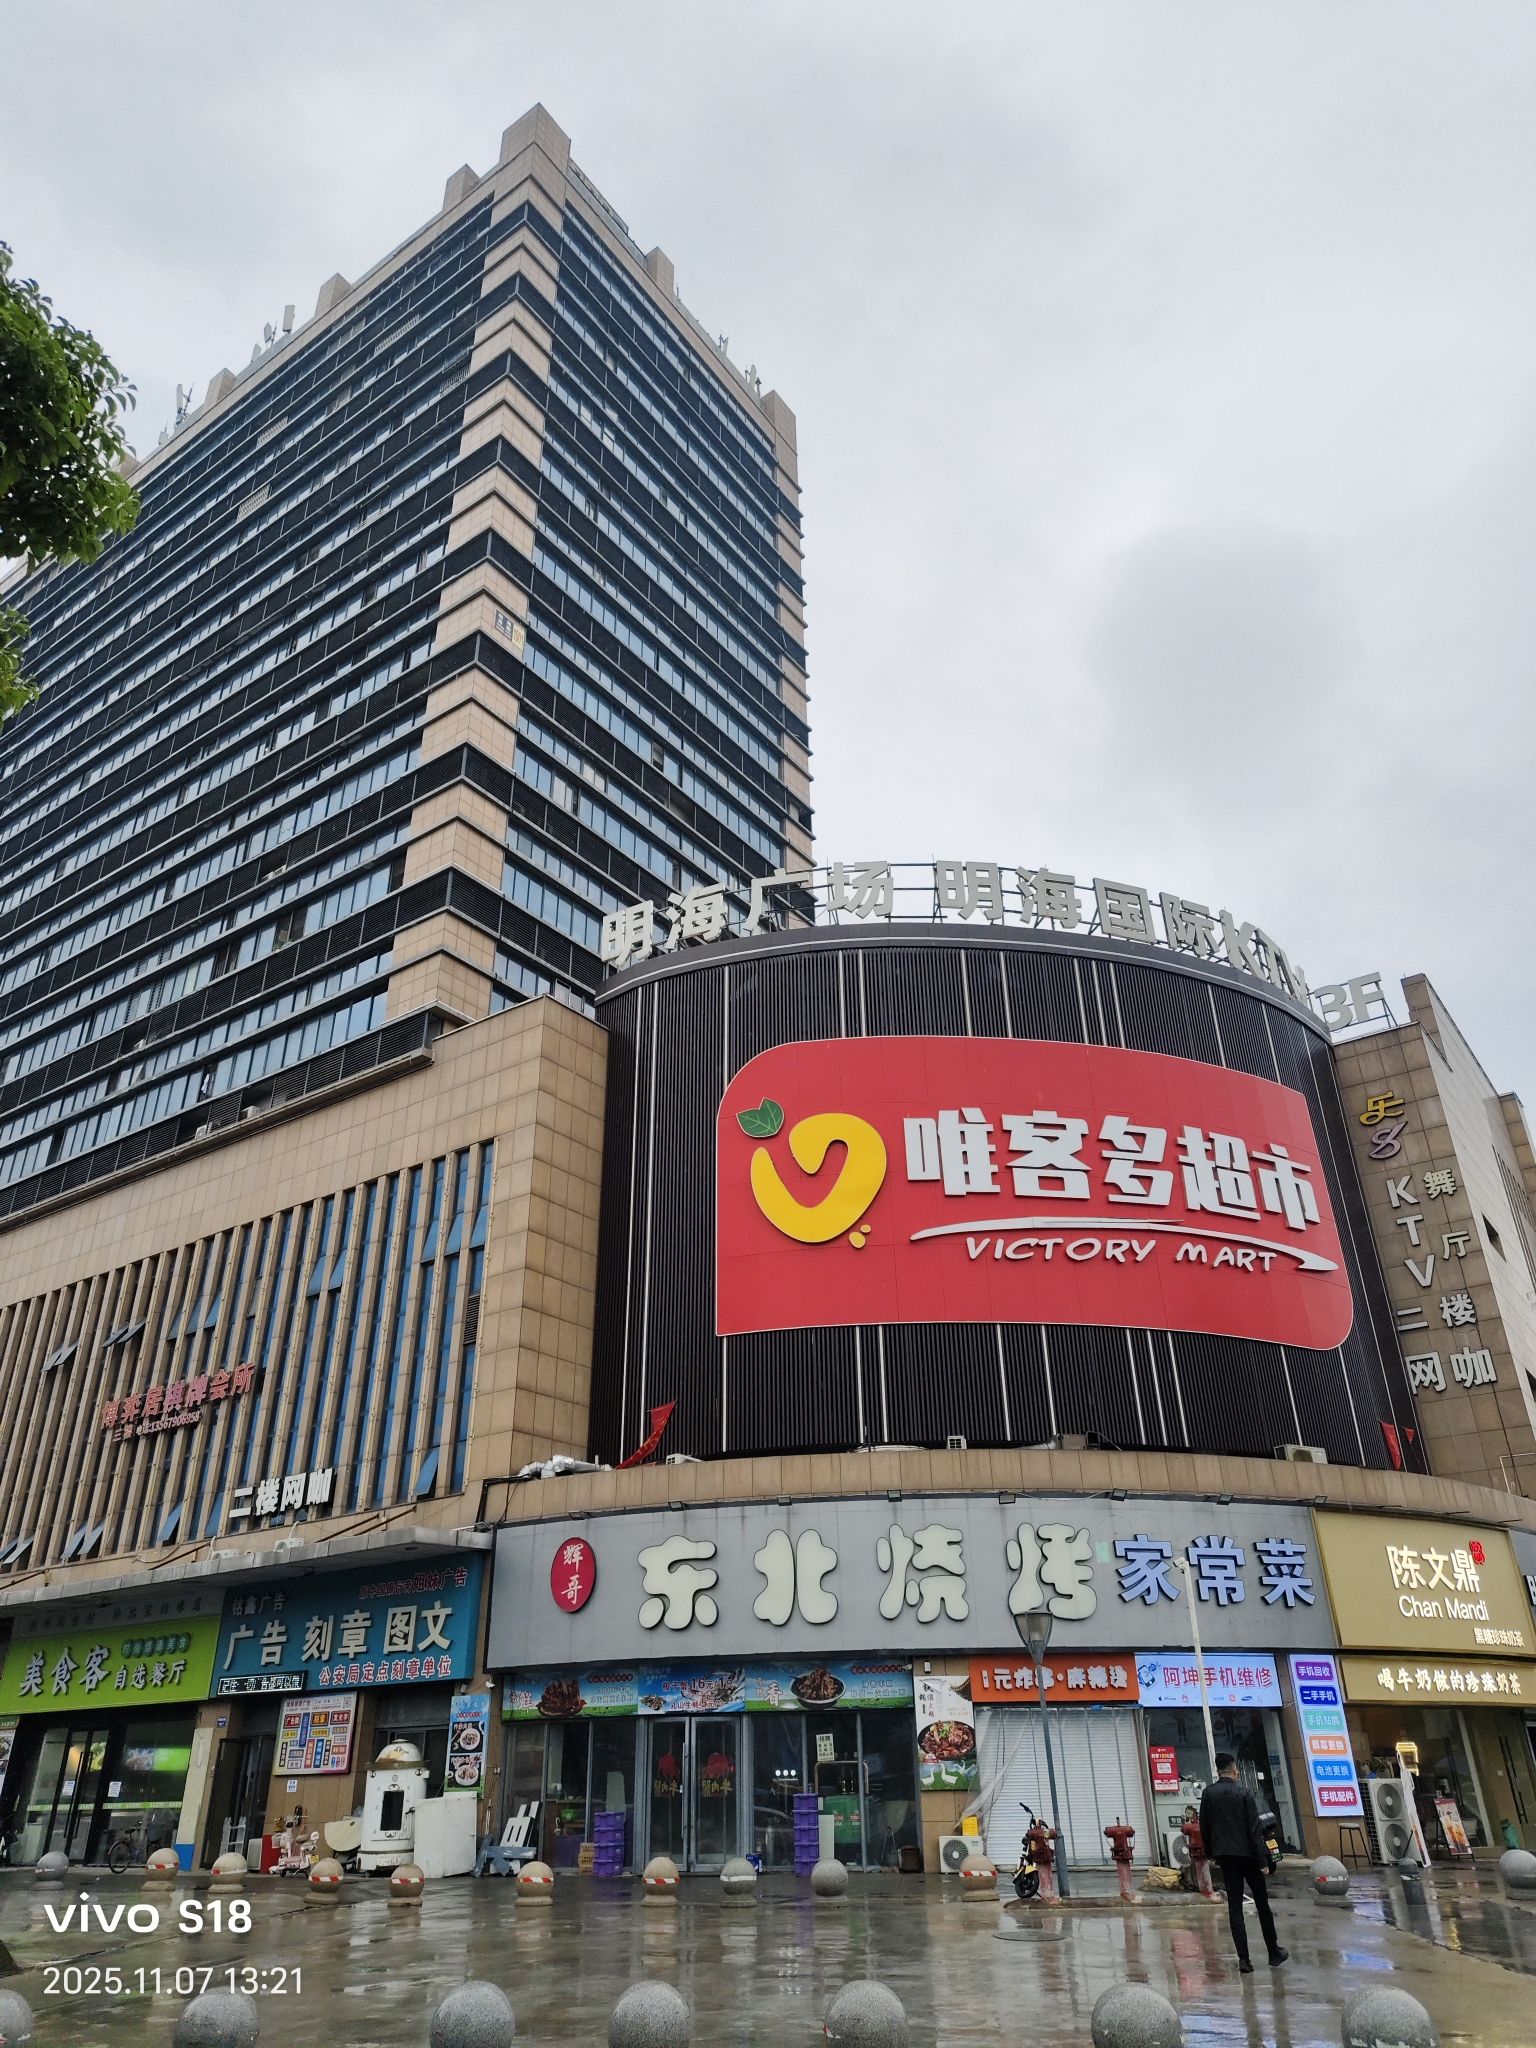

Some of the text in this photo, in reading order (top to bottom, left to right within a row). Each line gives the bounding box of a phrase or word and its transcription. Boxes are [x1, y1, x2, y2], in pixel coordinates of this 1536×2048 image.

[602, 861, 895, 971] 明海广场
[903, 1107, 1322, 1231] 唯客多超市
[1386, 1175, 1435, 1288] KTV
[1423, 1168, 1471, 1260] 舞厅
[966, 1236, 1278, 1272] VICTORY MART
[1397, 1294, 1477, 1333] 二楼
[1405, 1346, 1498, 1395] 网咖
[101, 1361, 257, 1430] 博弈居棋牌会所
[229, 1467, 337, 1519] 二楼网咖
[561, 1543, 584, 1605] 辉哥
[637, 1522, 1317, 1631] 东北烧烤 家常菜
[1386, 1545, 1480, 1593] 陈文鼎
[1399, 1595, 1490, 1621] Chan Mandi
[222, 1599, 454, 1671] 广告 刻章 图文
[1473, 1627, 1525, 1648] 黑糖珍珠奶茶
[18, 1645, 187, 1697] 美食客 自选餐厅
[318, 1655, 453, 1686] 公安局定点刻章单位
[1162, 1666, 1273, 1687] 阿坤手机维修
[1298, 1666, 1331, 1677] 手机回收
[1376, 1667, 1522, 1695] 喝牛奶做的珍珠奶茶
[1302, 1690, 1336, 1701] 二手手机
[1307, 1715, 1341, 1726] 手机贴膜
[1311, 1740, 1345, 1751] 屏幕更换
[1316, 1765, 1350, 1776] 电池更换
[1321, 1791, 1355, 1803] 手机配件
